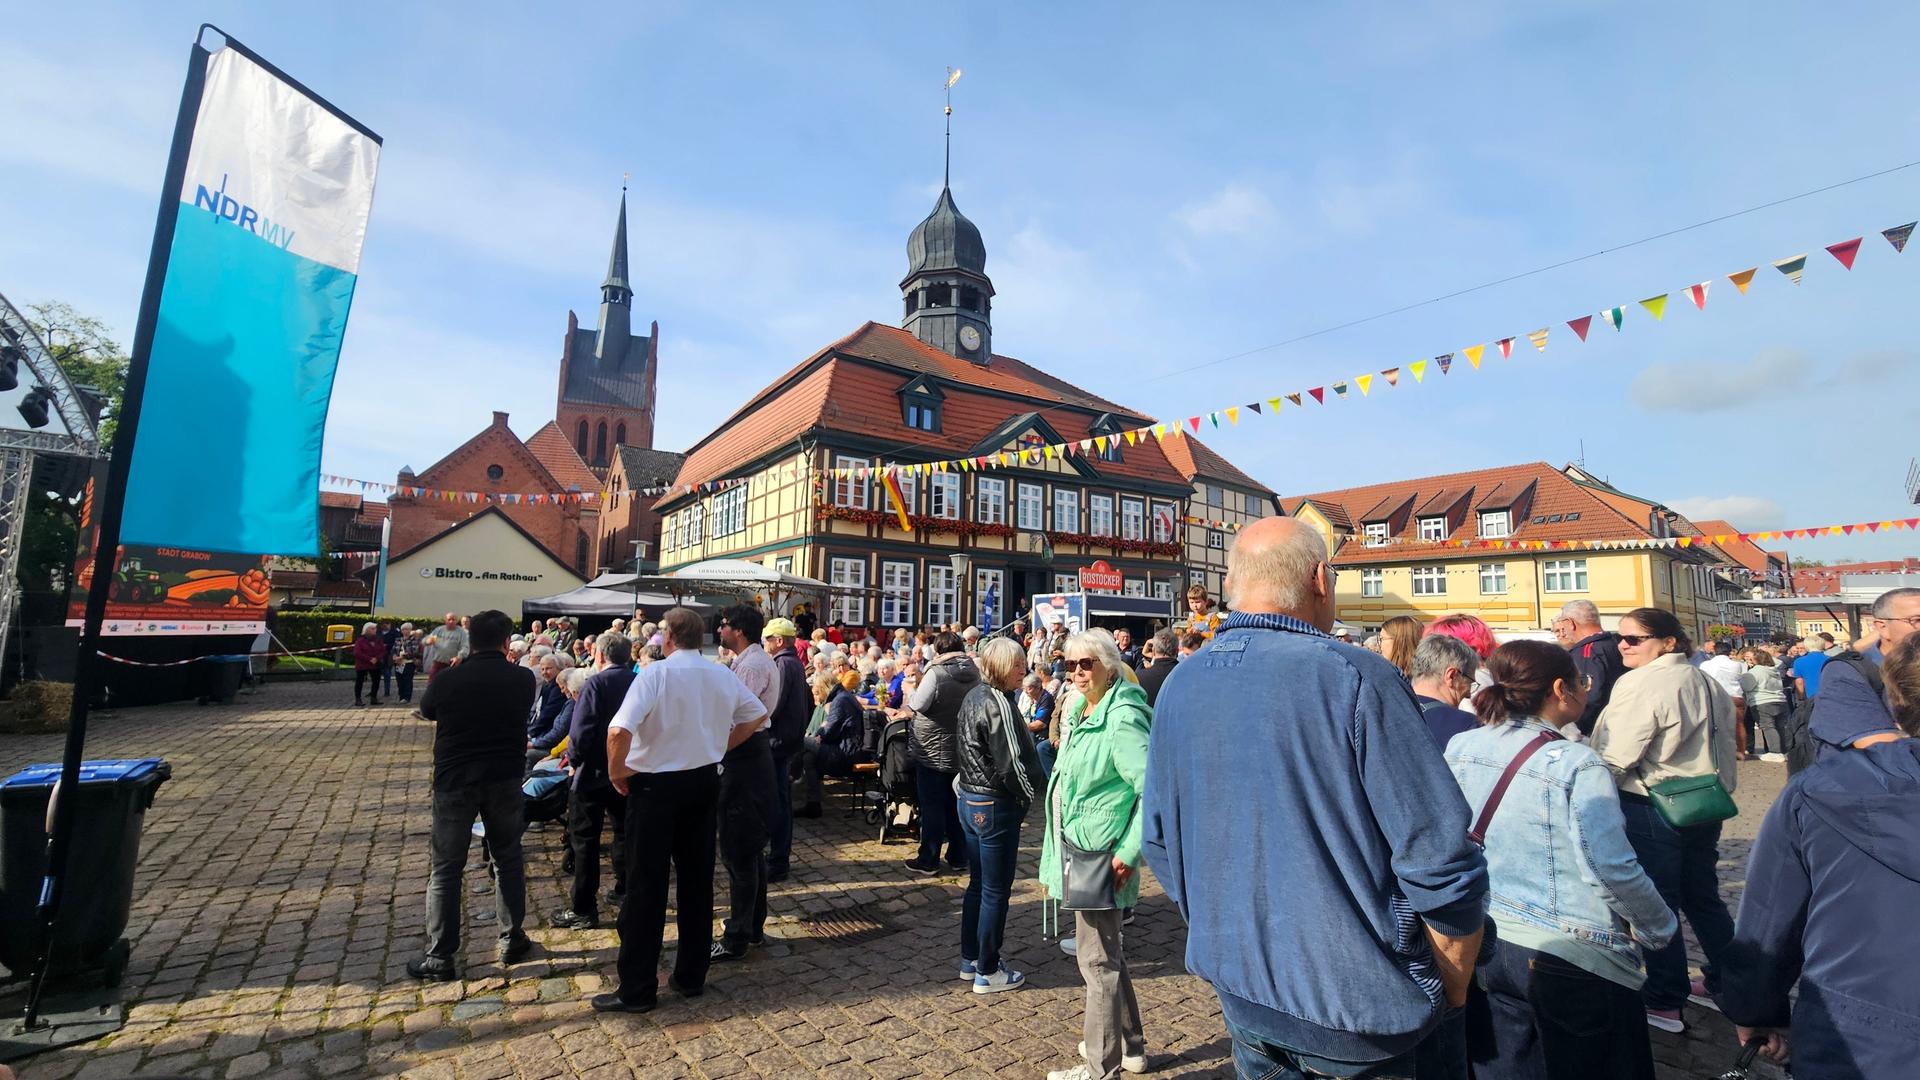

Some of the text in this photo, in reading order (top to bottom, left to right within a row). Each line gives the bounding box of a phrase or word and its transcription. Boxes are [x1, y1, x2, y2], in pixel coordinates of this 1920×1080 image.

[194, 178, 295, 250] NDR MV
[157, 548, 212, 561] STADT GRABOW
[435, 567, 473, 579] Bistro
[1082, 572, 1120, 586] ROSTOCKER
